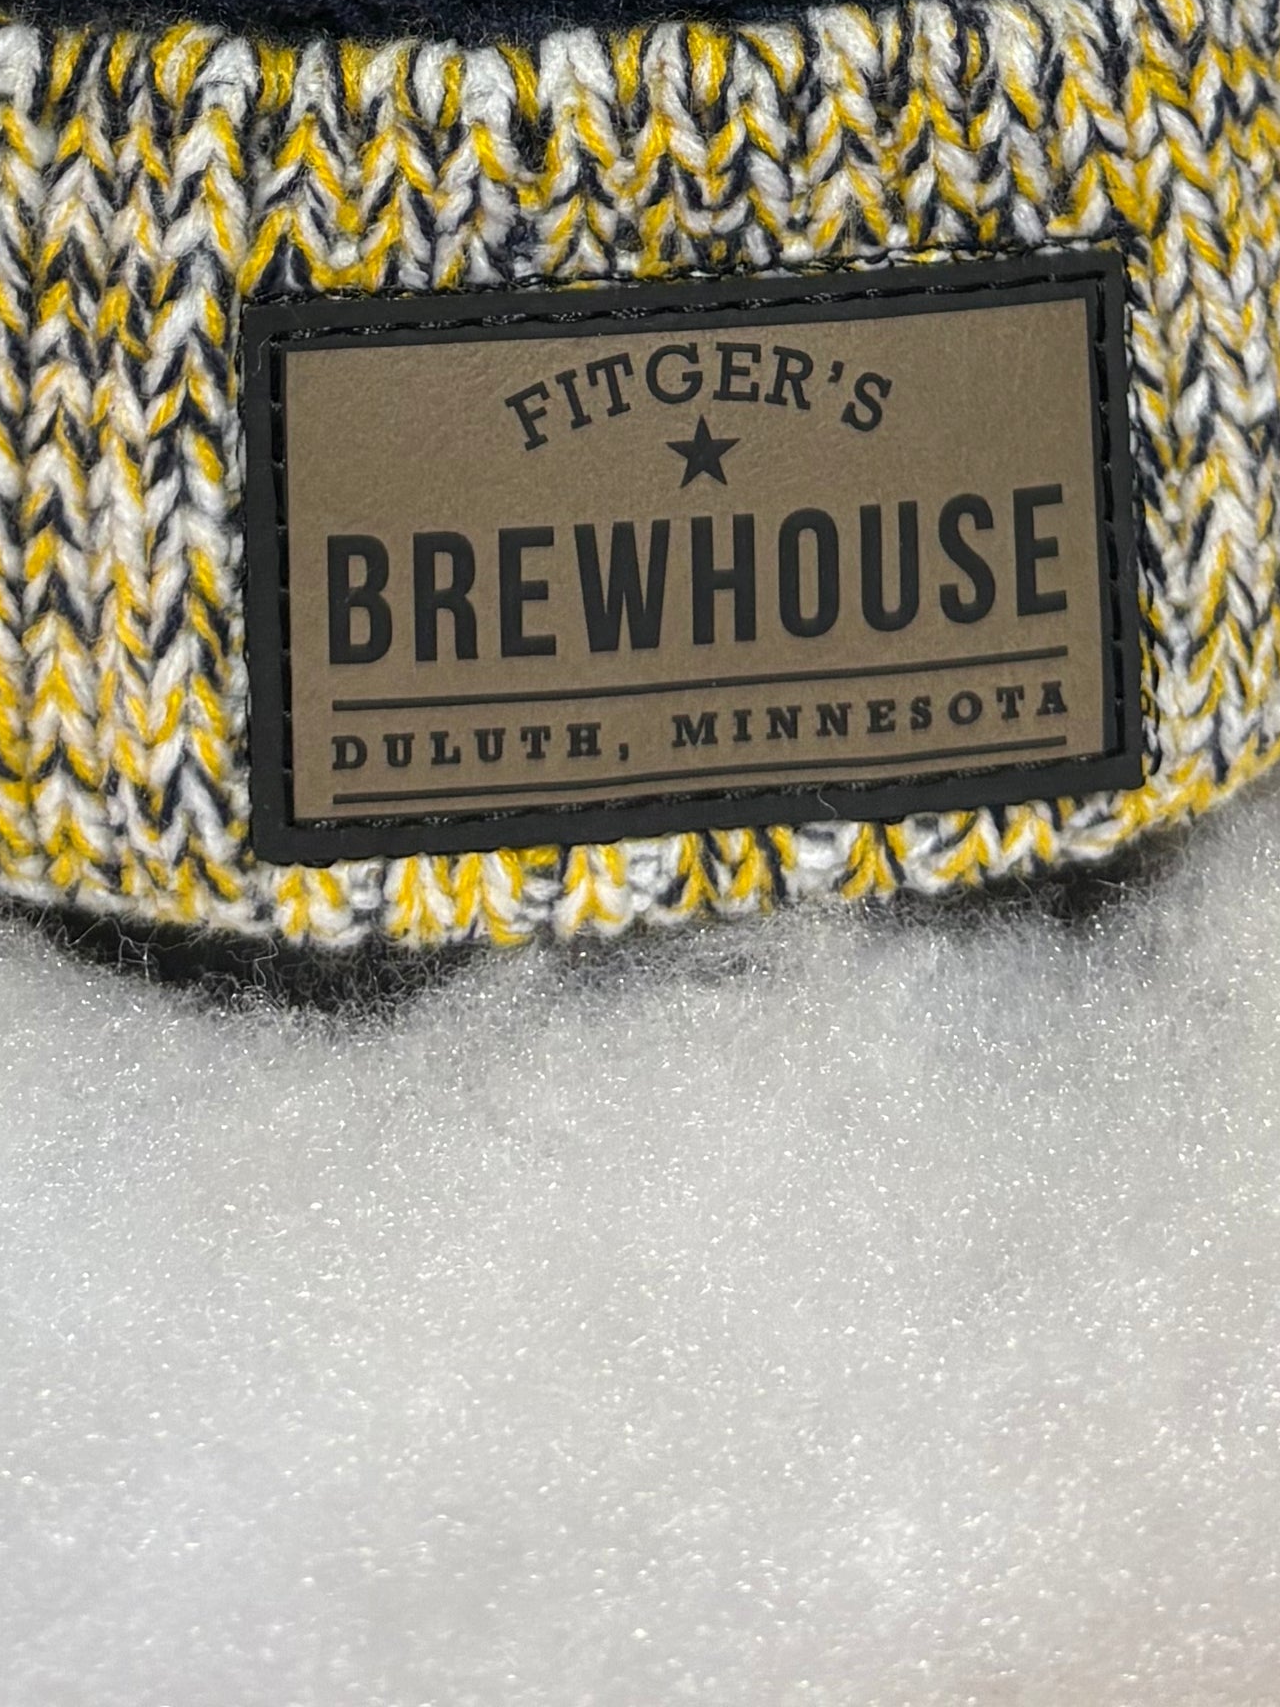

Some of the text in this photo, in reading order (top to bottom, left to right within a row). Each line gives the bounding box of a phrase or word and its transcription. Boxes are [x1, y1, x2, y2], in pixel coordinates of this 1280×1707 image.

[503, 341, 893, 451] FITGER'S
[326, 483, 1068, 666] BREWHOUSE
[331, 680, 1069, 773] DULUTH, MINNESOTA
